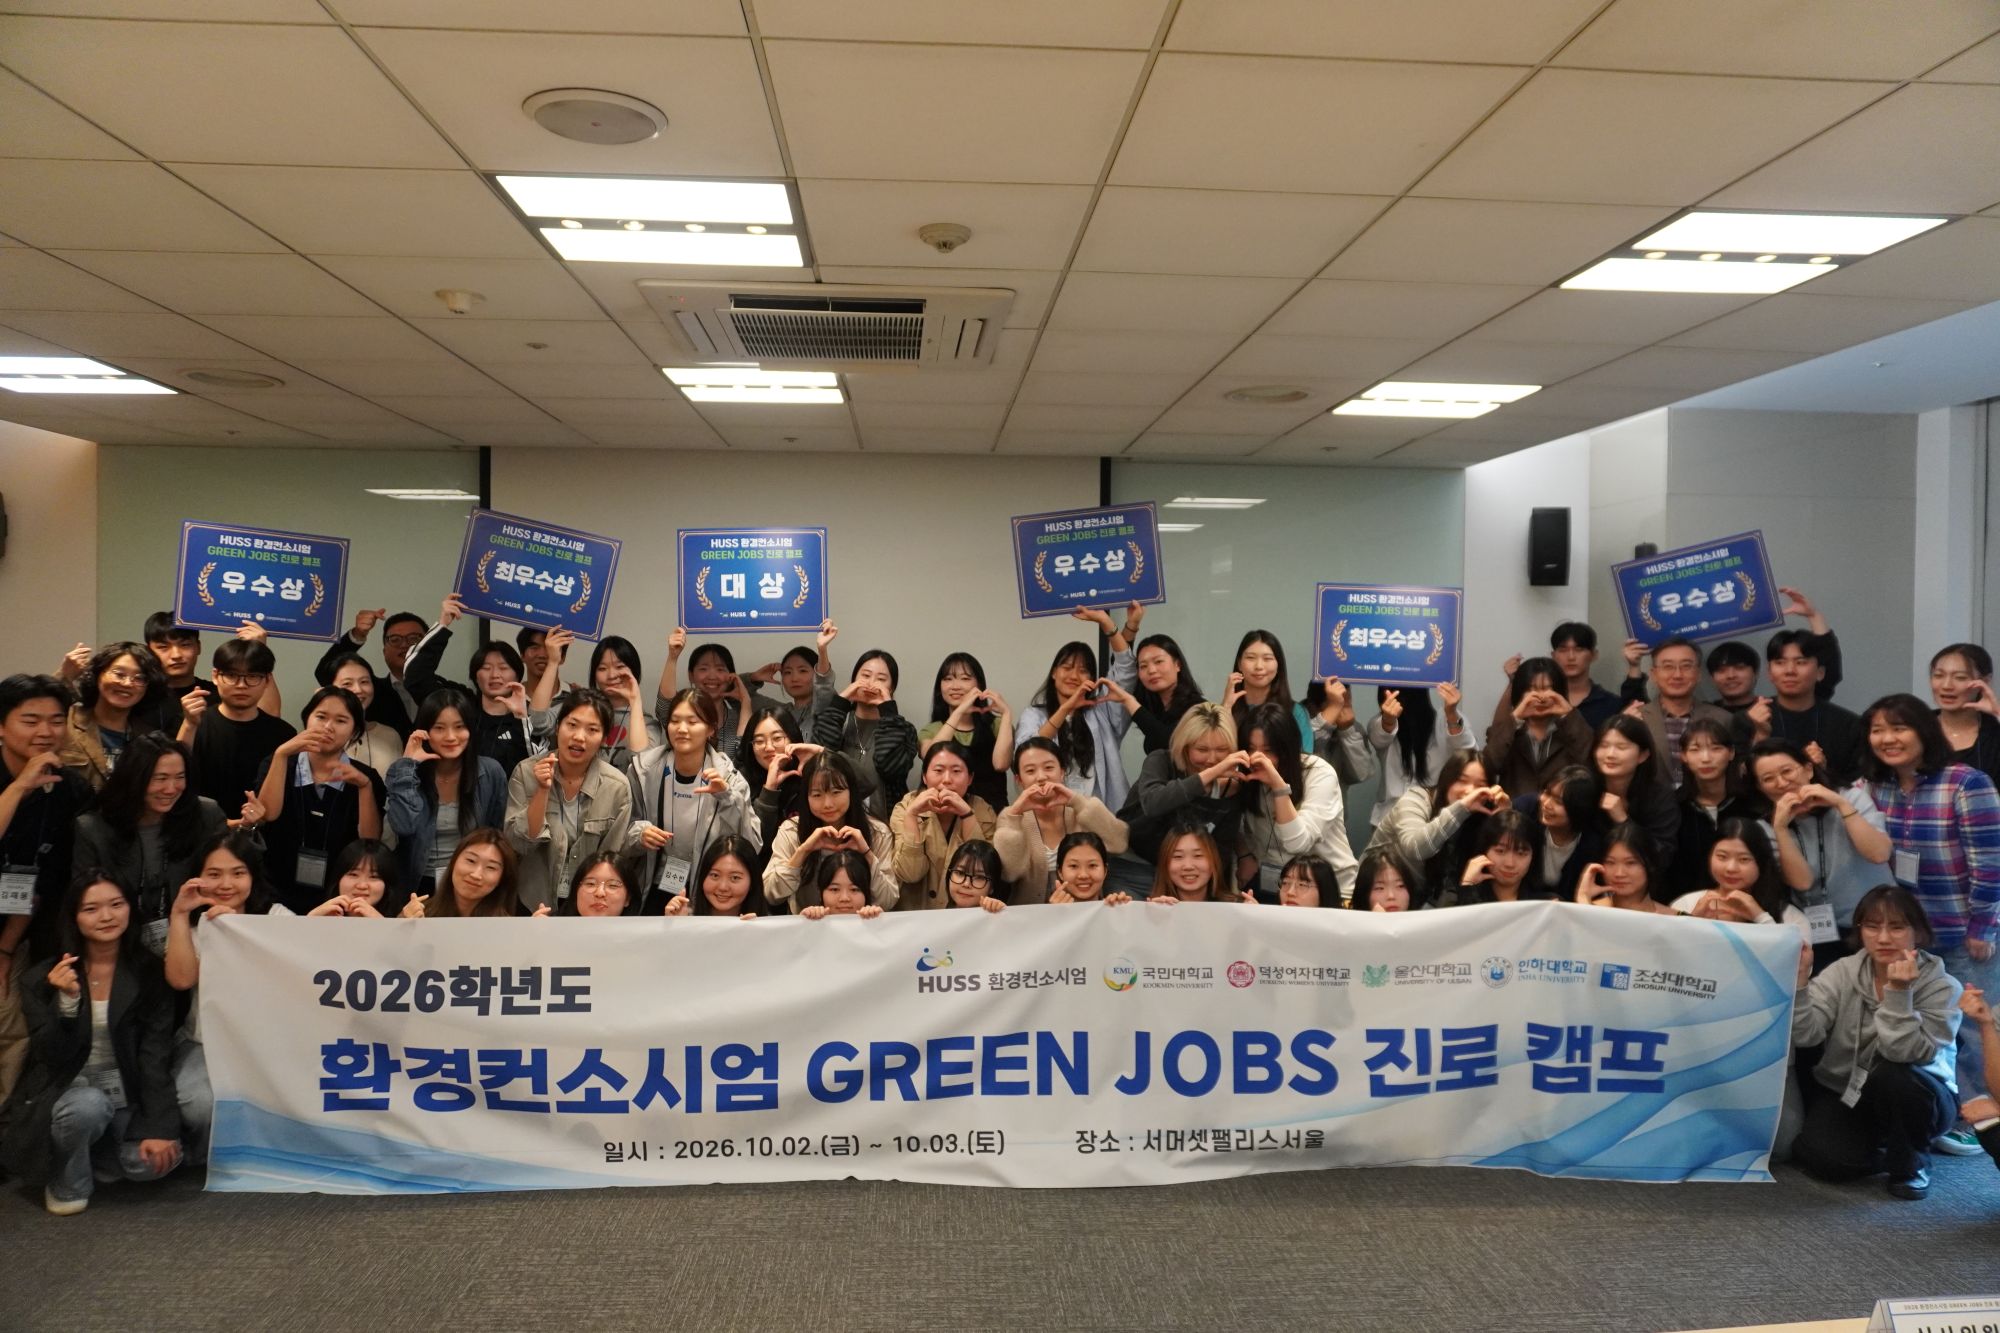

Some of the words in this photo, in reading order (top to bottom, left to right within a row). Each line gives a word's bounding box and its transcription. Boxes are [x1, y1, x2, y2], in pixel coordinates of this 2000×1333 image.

[1045, 520, 1072, 533] HUSS
[1074, 515, 1124, 529] 환경컨소시엄
[219, 534, 251, 547] HUSS
[254, 538, 311, 554] 환경컨소시엄
[502, 524, 531, 539] HUSS
[532, 531, 585, 552] 환경컨소시엄
[711, 538, 739, 549] HUSS
[740, 537, 792, 548] 환경컨소시엄
[1037, 532, 1070, 544] GREEN
[1072, 529, 1098, 541] JOBS
[1100, 528, 1117, 537] 진로
[207, 545, 246, 559] GREEN
[248, 550, 278, 562] JOBS
[280, 554, 300, 564] 진로
[489, 534, 524, 550] GREEN
[526, 543, 553, 557] JOBS
[554, 549, 573, 561] 진로
[701, 550, 735, 560] GREEN
[737, 550, 763, 560] JOBS
[766, 550, 784, 559] 진로
[1639, 573, 1674, 587] GREEN
[1676, 567, 1703, 580] JOBS
[1646, 561, 1676, 575] HUSS
[494, 560, 575, 597] 최우수상
[1070, 591, 1086, 599] HUSS
[1349, 593, 1377, 604] HUSS
[1378, 594, 1430, 606] 환경컨소시엄
[504, 600, 521, 609] HUSS
[1338, 604, 1373, 614] GREEN
[1374, 606, 1401, 616] JOBS
[233, 611, 251, 619] HUSS
[1349, 627, 1427, 650] 최우수상
[1113, 967, 1134, 975] KMU
[1142, 966, 1213, 980] 국민대학교
[1259, 966, 1351, 980] 덕성여자대학교
[1394, 962, 1472, 979] 울산대학교
[1518, 958, 1588, 974] 인하대학교
[918, 974, 981, 993] HUSS
[987, 967, 1087, 991] 환경컨소시엄
[1633, 969, 1718, 993] 조선대학교
[313, 965, 592, 1016] 2026학년도
[1633, 982, 1666, 992] CHOSUN
[1668, 986, 1717, 1000] UNIVERSITY
[319, 1038, 779, 1114] 환경컨소시엄
[806, 1029, 1090, 1104] GREEN
[1113, 1028, 1340, 1097] JOBS
[1363, 1023, 1499, 1098] 진로
[1526, 1022, 1670, 1094] 캠프
[604, 1140, 648, 1163] 일시
[674, 1133, 861, 1160] 2026.10.02.(금)
[893, 1130, 1005, 1156] 10.03.(토)
[1075, 1129, 1121, 1155] 장소
[1142, 1129, 1326, 1154] 서머셋팰리스서울
